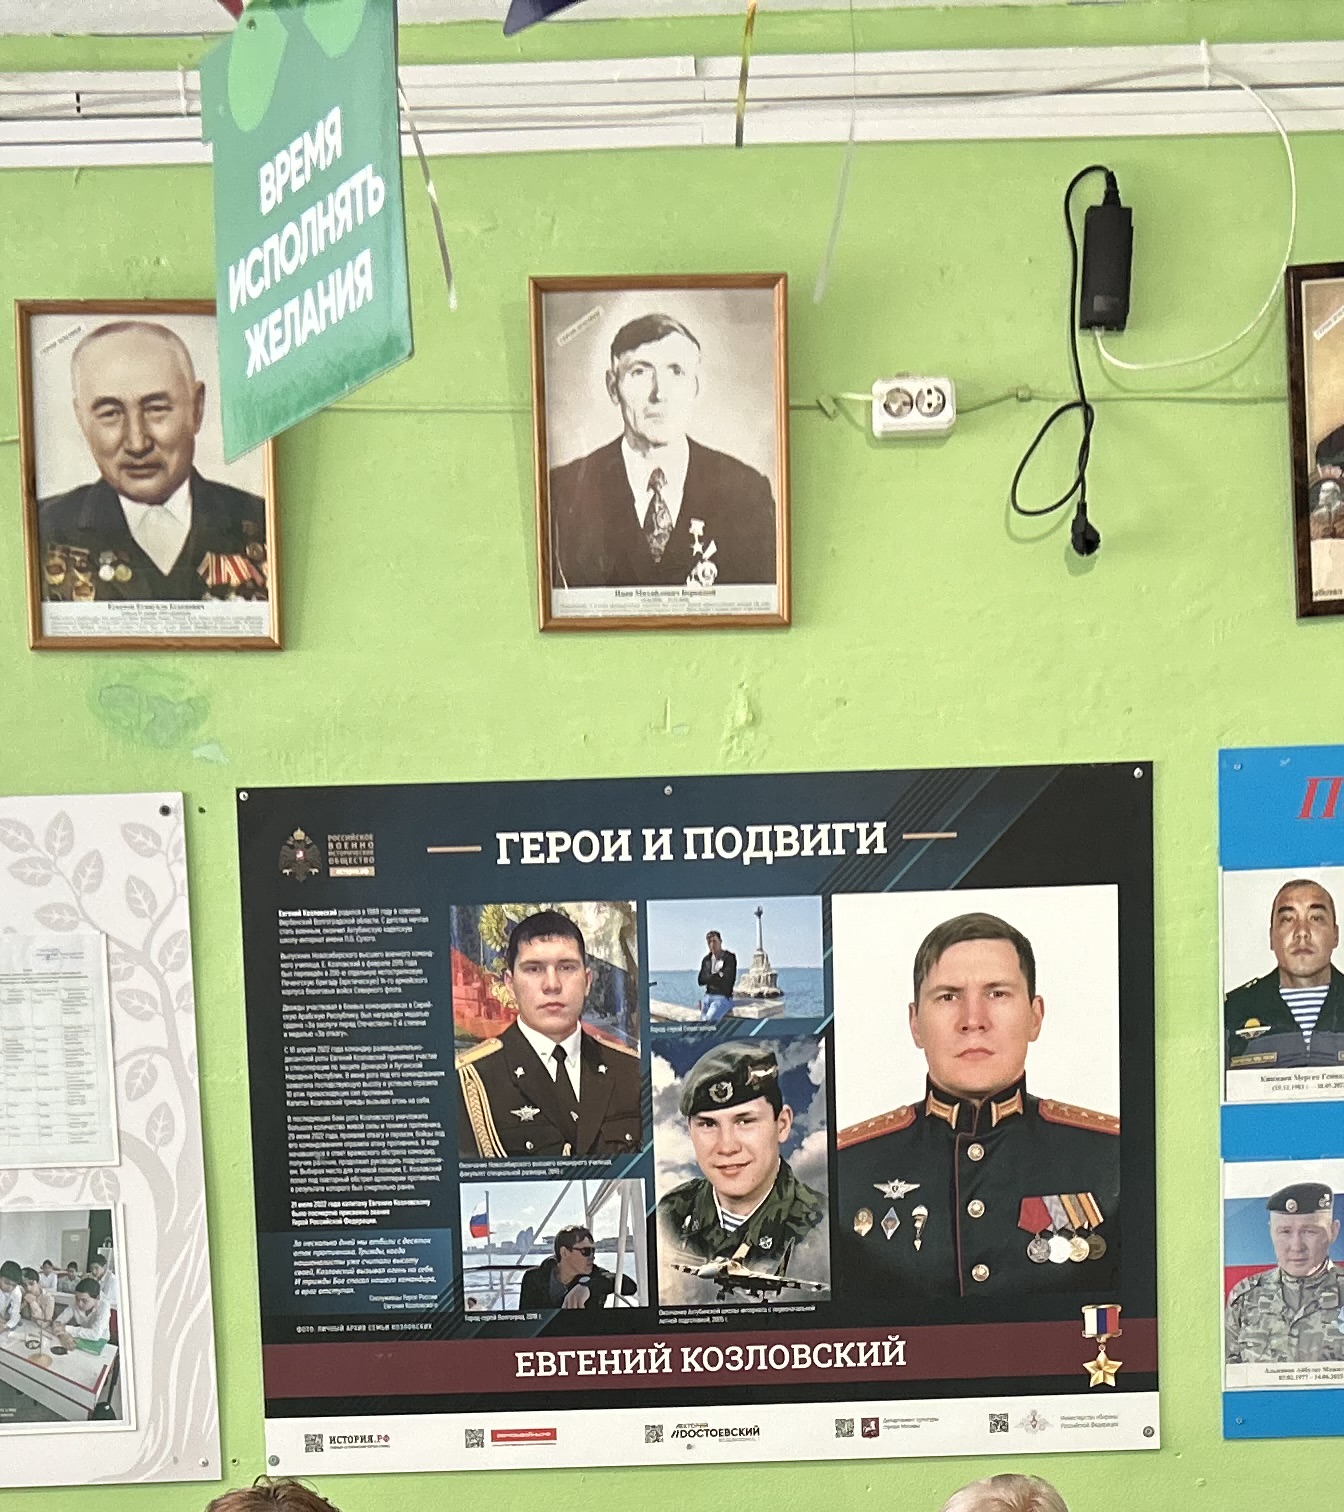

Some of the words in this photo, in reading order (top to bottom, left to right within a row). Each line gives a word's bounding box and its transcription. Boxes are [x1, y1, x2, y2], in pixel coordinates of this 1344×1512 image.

[259, 106, 342, 215] ВРЕМЯ
[228, 164, 385, 313] ИСПОЛНЯТЬ
[245, 250, 373, 378] ЖЕЛАНИЯ
[496, 829, 632, 865] ГЕРОИ
[642, 828, 673, 862] И
[684, 821, 888, 866] ПОДВИГИ
[515, 1342, 674, 1378] ЕВГЕНИЙ
[681, 1335, 907, 1373] КОЗЛОВСКИЙ
[329, 1433, 391, 1446] ИСТОРИЯ.РФ
